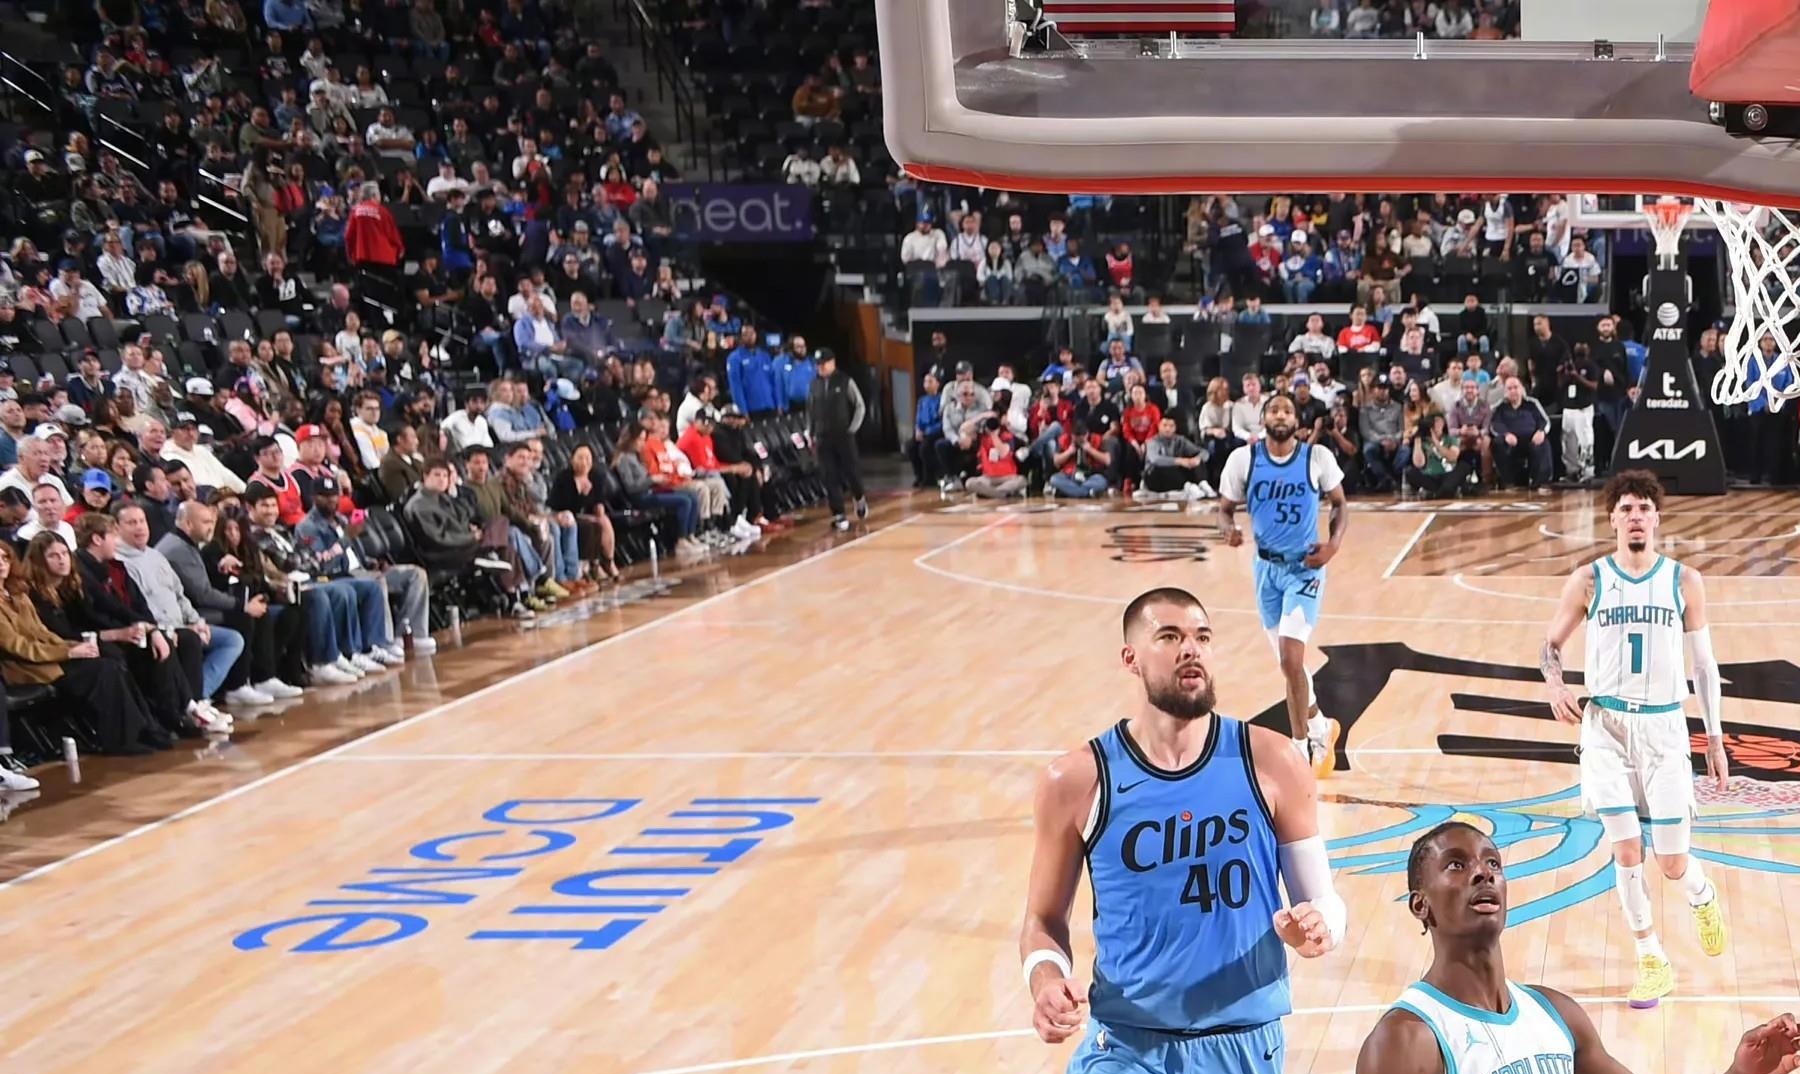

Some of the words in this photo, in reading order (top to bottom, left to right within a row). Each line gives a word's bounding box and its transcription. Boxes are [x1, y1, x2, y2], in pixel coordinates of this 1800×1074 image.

[1653, 328, 1684, 341] AT&T
[1646, 399, 1690, 409] teradata
[1254, 479, 1306, 501] Clips
[1274, 503, 1302, 525] 55
[1597, 605, 1675, 628] CHARLOTTE
[1627, 633, 1643, 674] 1
[1120, 804, 1250, 873] Clips
[1179, 858, 1251, 914] 40
